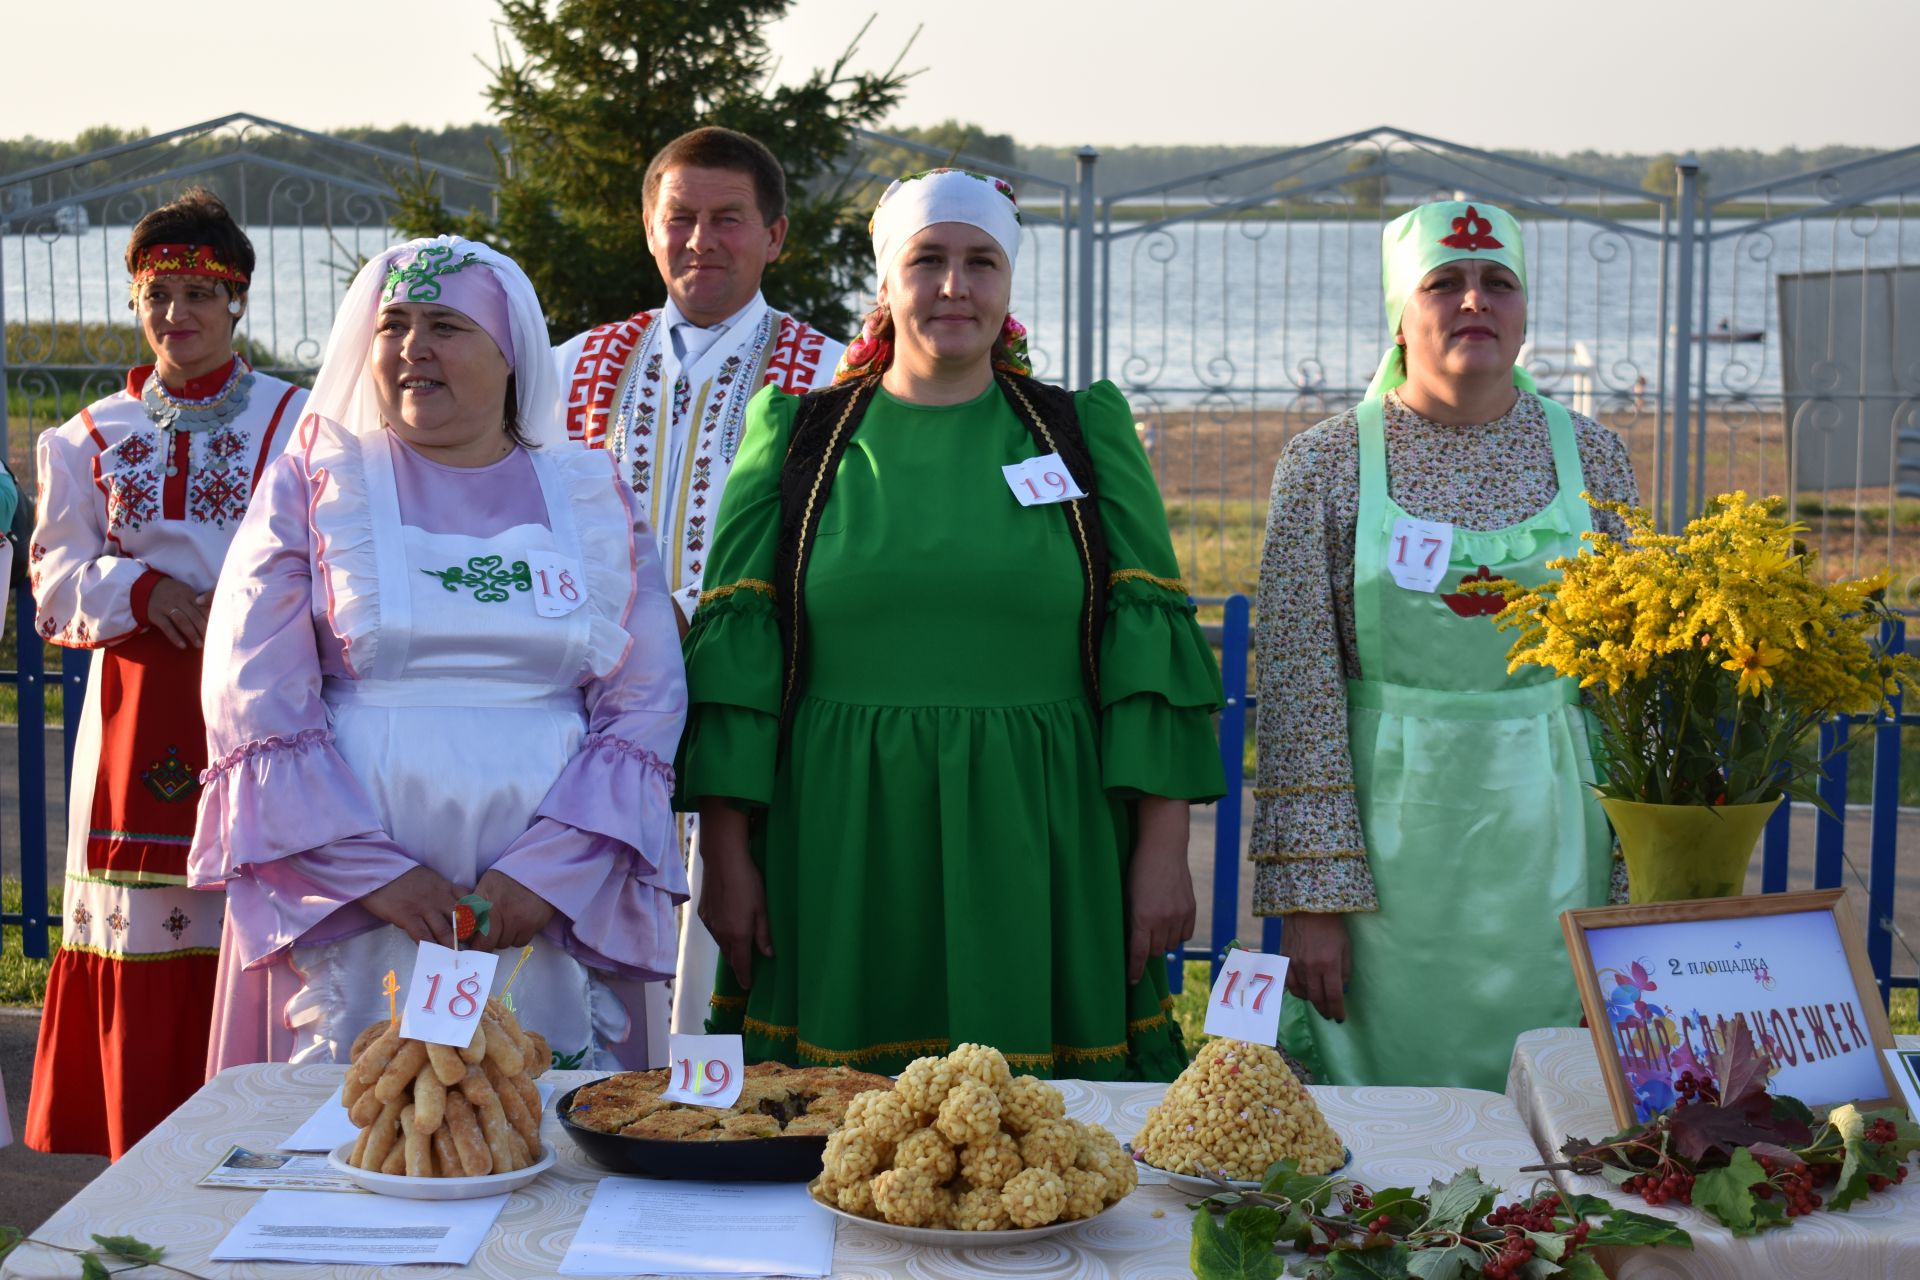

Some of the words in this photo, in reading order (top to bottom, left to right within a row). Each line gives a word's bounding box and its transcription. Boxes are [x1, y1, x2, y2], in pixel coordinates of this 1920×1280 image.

[1020, 471, 1068, 499] 19
[1395, 535, 1442, 568] 17
[535, 569, 579, 602] 18
[1668, 958, 1683, 975] 2
[1688, 957, 1769, 975] ПЛОЩАДКА
[421, 971, 480, 1018] 18
[1220, 970, 1275, 1012] 17
[1616, 1016, 1673, 1073] ПИР
[1682, 1001, 1868, 1073] СЛКОЕЖЕК
[677, 1058, 731, 1097] 19
